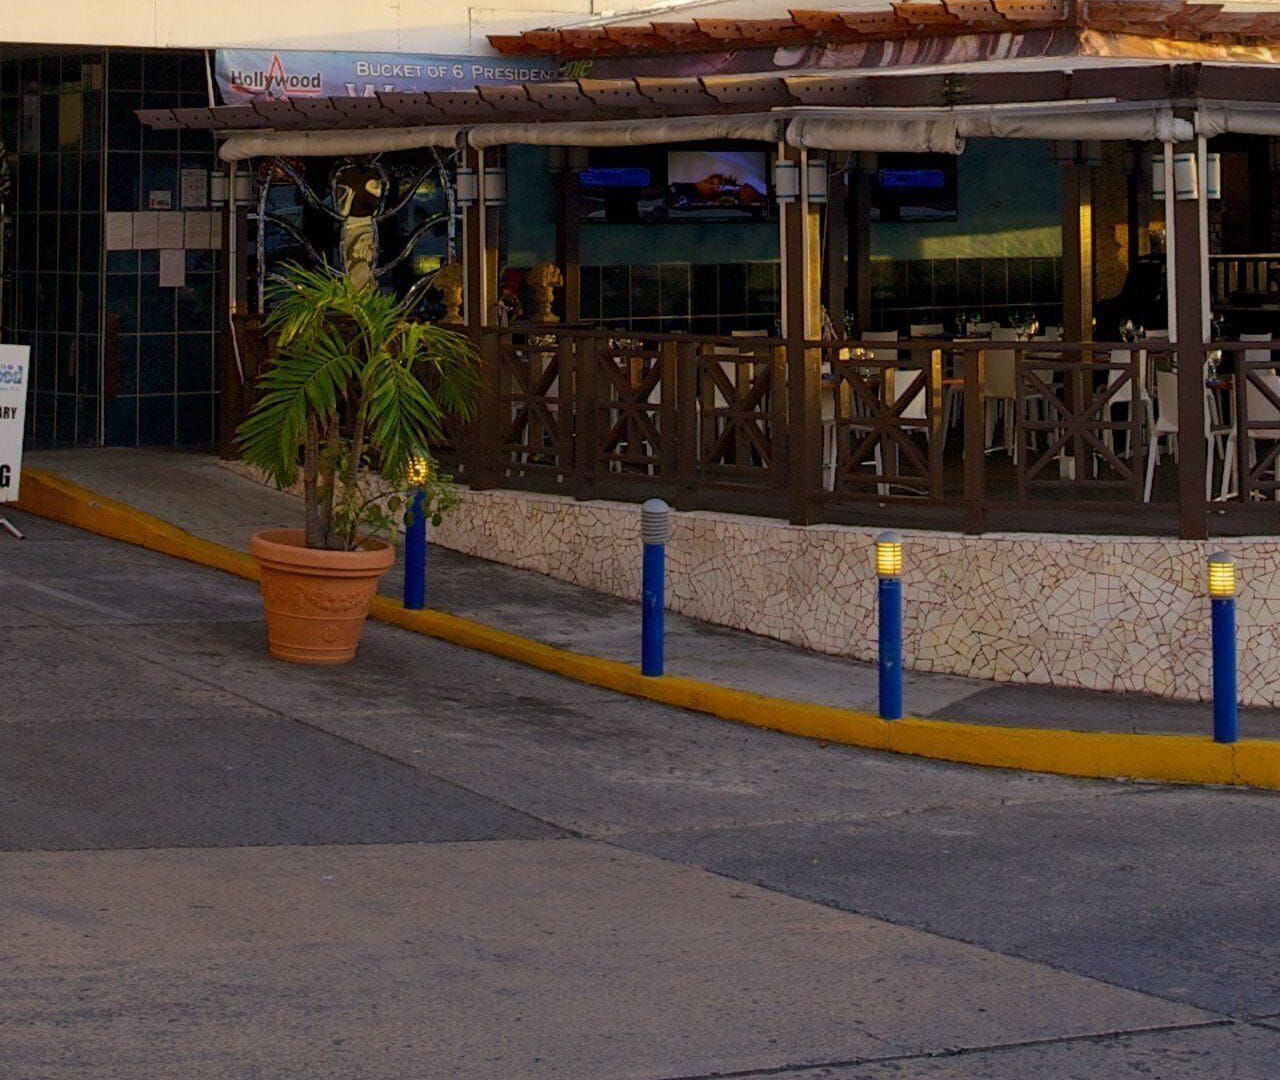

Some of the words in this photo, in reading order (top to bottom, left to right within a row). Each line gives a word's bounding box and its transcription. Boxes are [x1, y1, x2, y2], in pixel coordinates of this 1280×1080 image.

[231, 70, 322, 91] Hollywood
[355, 60, 422, 78] BUCKET
[451, 64, 464, 80] 6
[471, 65, 553, 81] PRESIDEN
